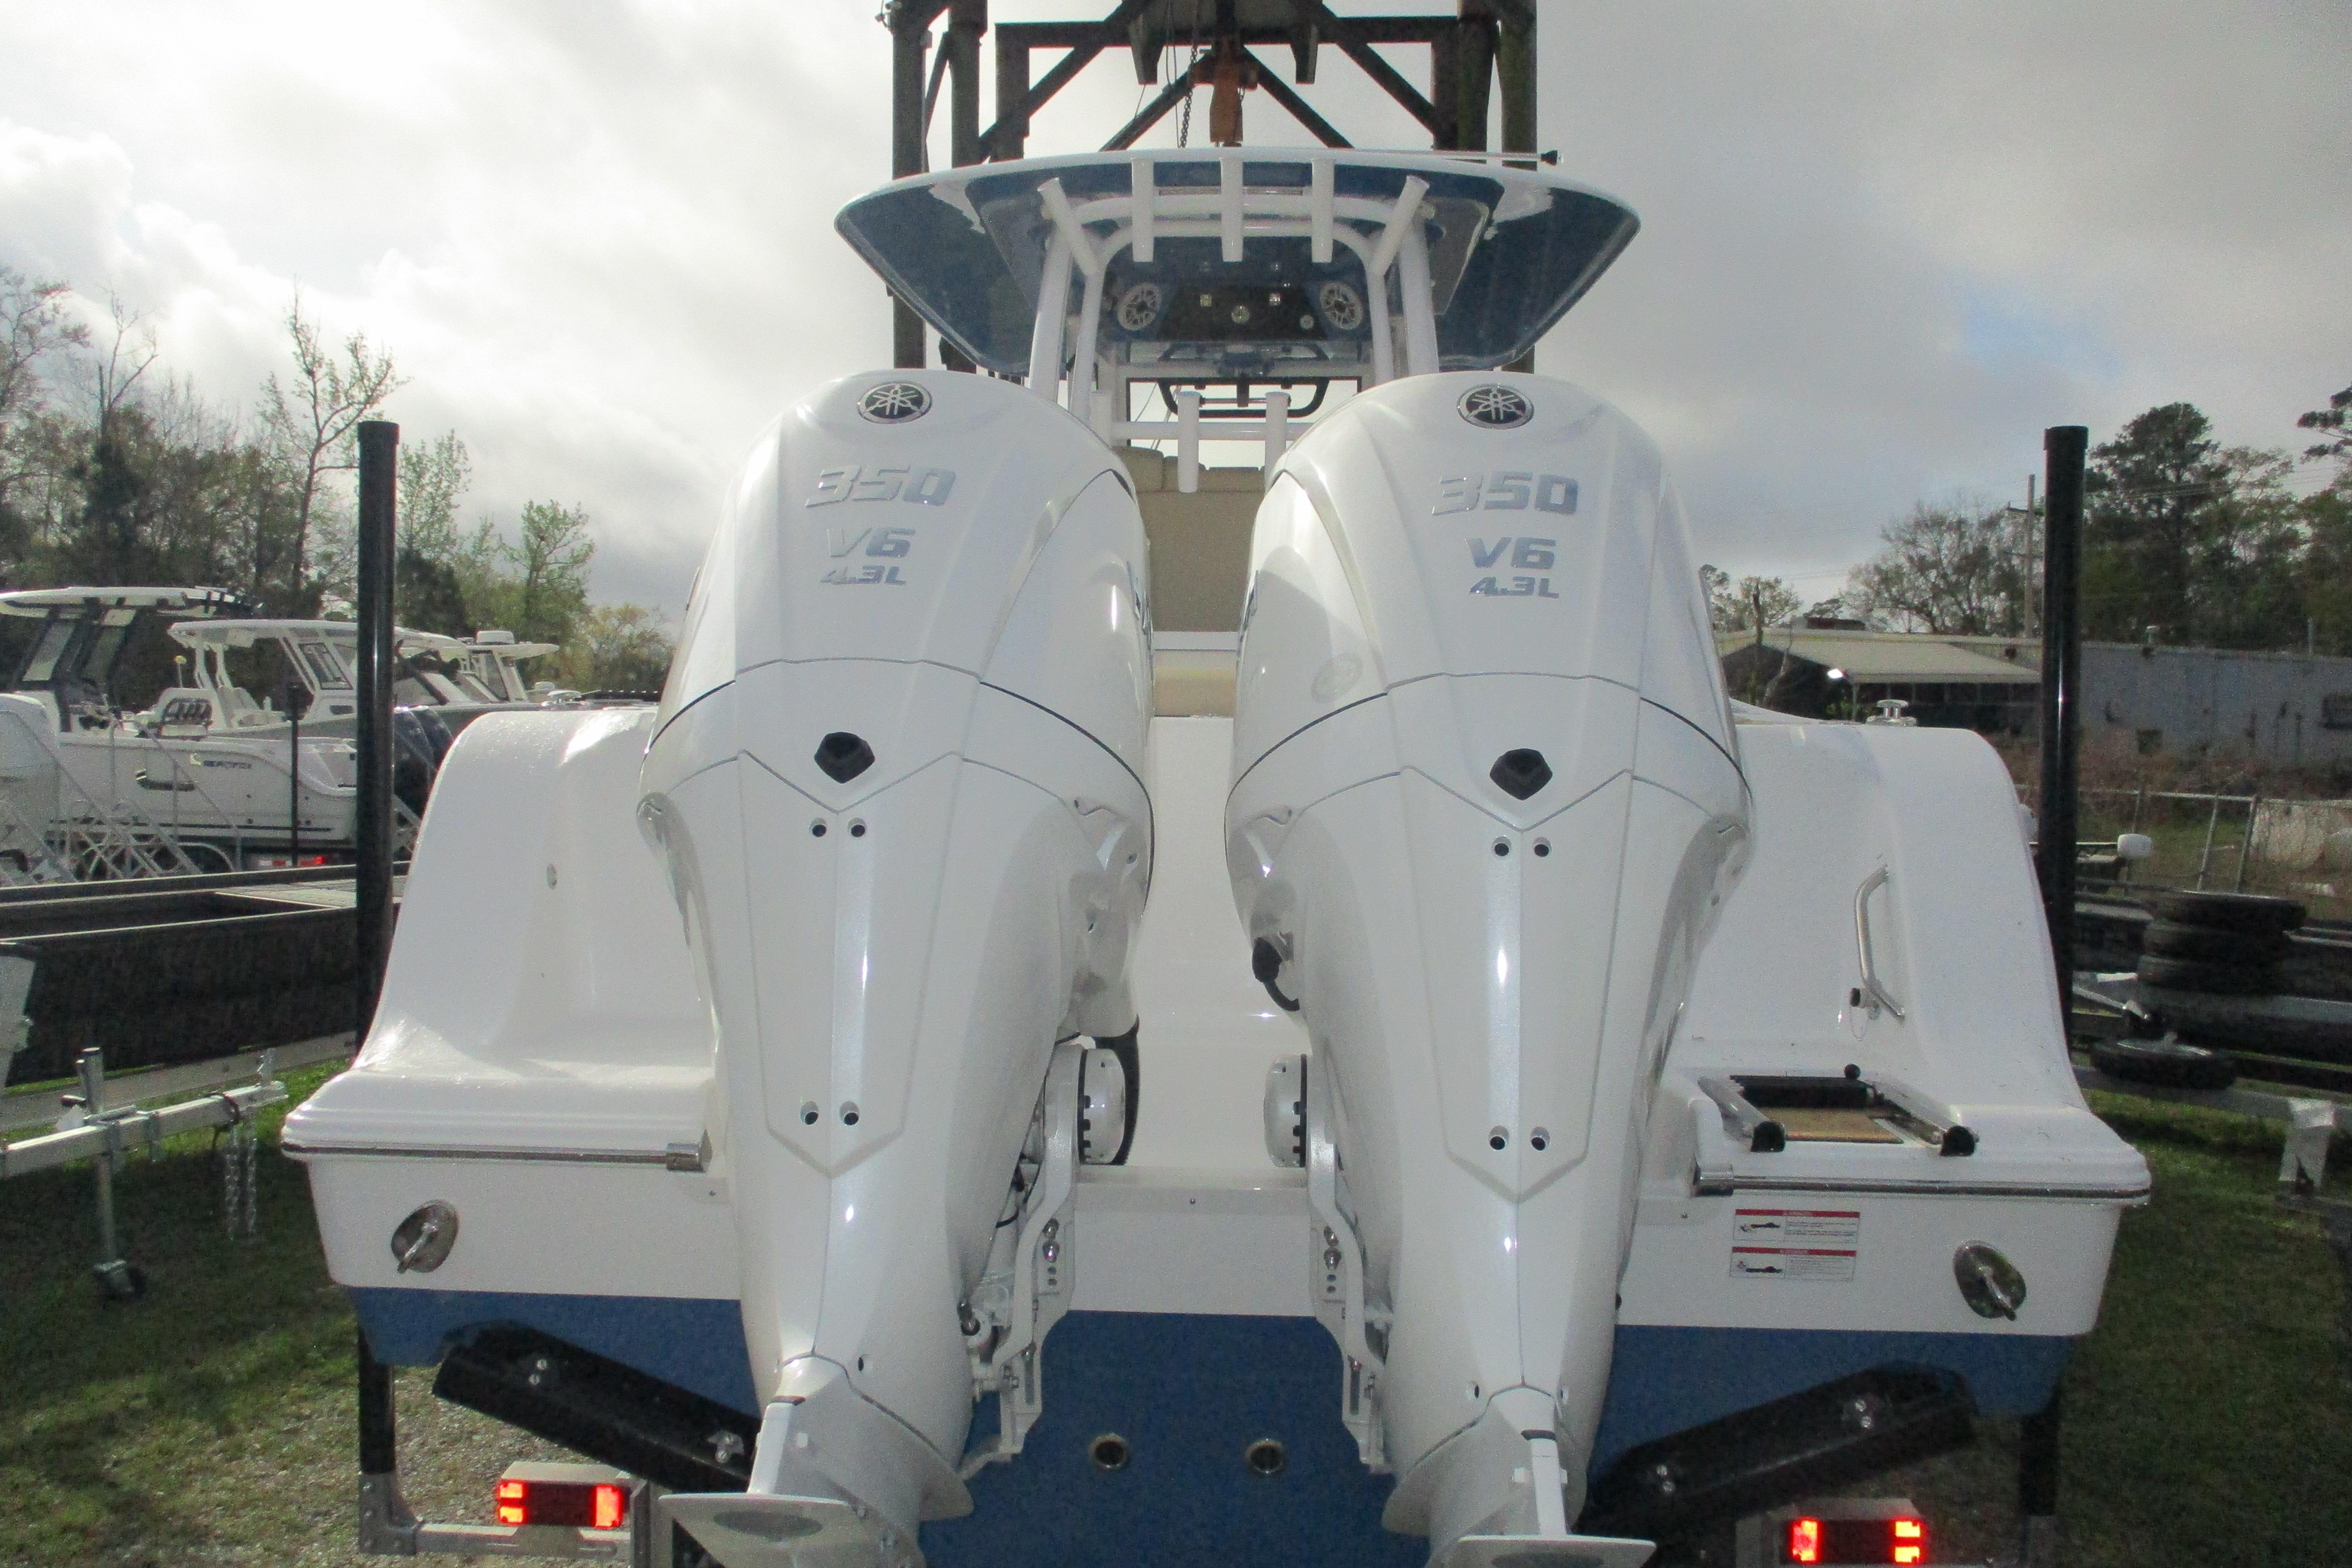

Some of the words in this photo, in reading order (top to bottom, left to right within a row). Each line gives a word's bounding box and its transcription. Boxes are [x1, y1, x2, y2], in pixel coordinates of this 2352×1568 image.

[805, 465, 956, 508] 350
[1432, 470, 1579, 516] 350
[826, 527, 916, 557] V6
[1465, 536, 1556, 569] V6
[820, 565, 906, 585] 4.3L
[1469, 576, 1559, 599] 4.3L
